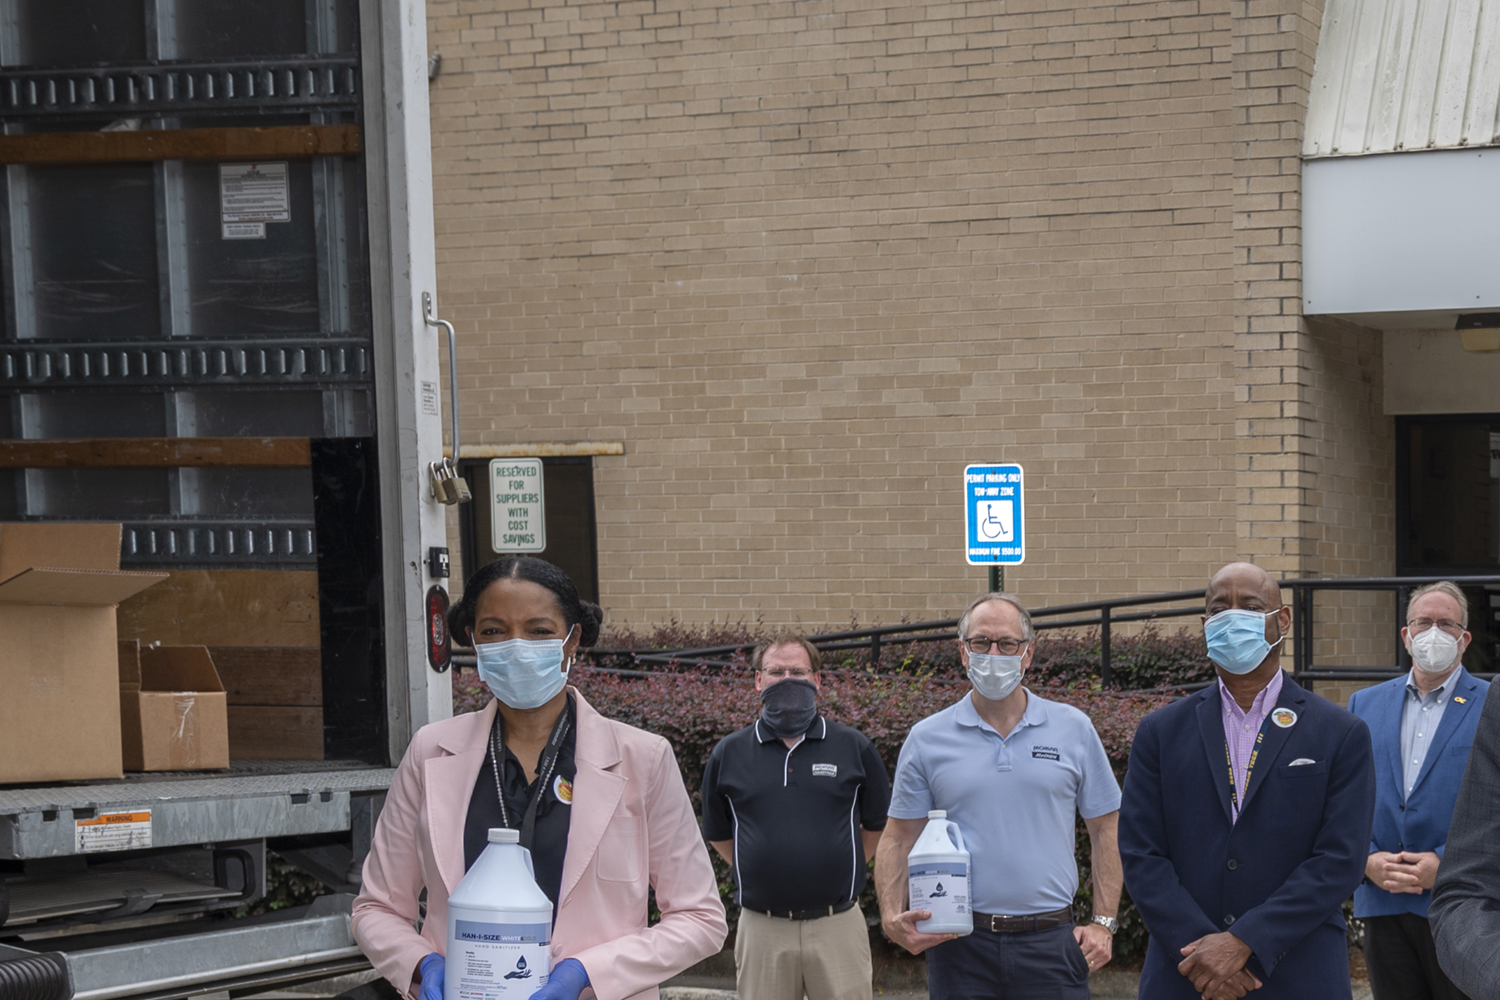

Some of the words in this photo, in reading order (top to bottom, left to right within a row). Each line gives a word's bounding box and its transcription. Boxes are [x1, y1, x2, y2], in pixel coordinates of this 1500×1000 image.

[496, 467, 537, 477] RESERVED
[966, 474, 985, 483] PERMIT
[986, 473, 1007, 483] PARKING
[1008, 473, 1021, 482] ONLY
[509, 480, 525, 490] FOR
[974, 487, 999, 496] TOW-AWAY
[1000, 487, 1014, 496] ZONE
[496, 493, 539, 503] SUPPLIERS
[507, 508, 529, 518] WITH
[508, 521, 528, 531] COST
[503, 533, 535, 544] SAVINGS
[969, 547, 990, 556] MAXIMUM
[991, 547, 1000, 555] FINE
[1248, 749, 1259, 769] TECH
[461, 932, 501, 941] HAN-I-SIZE
